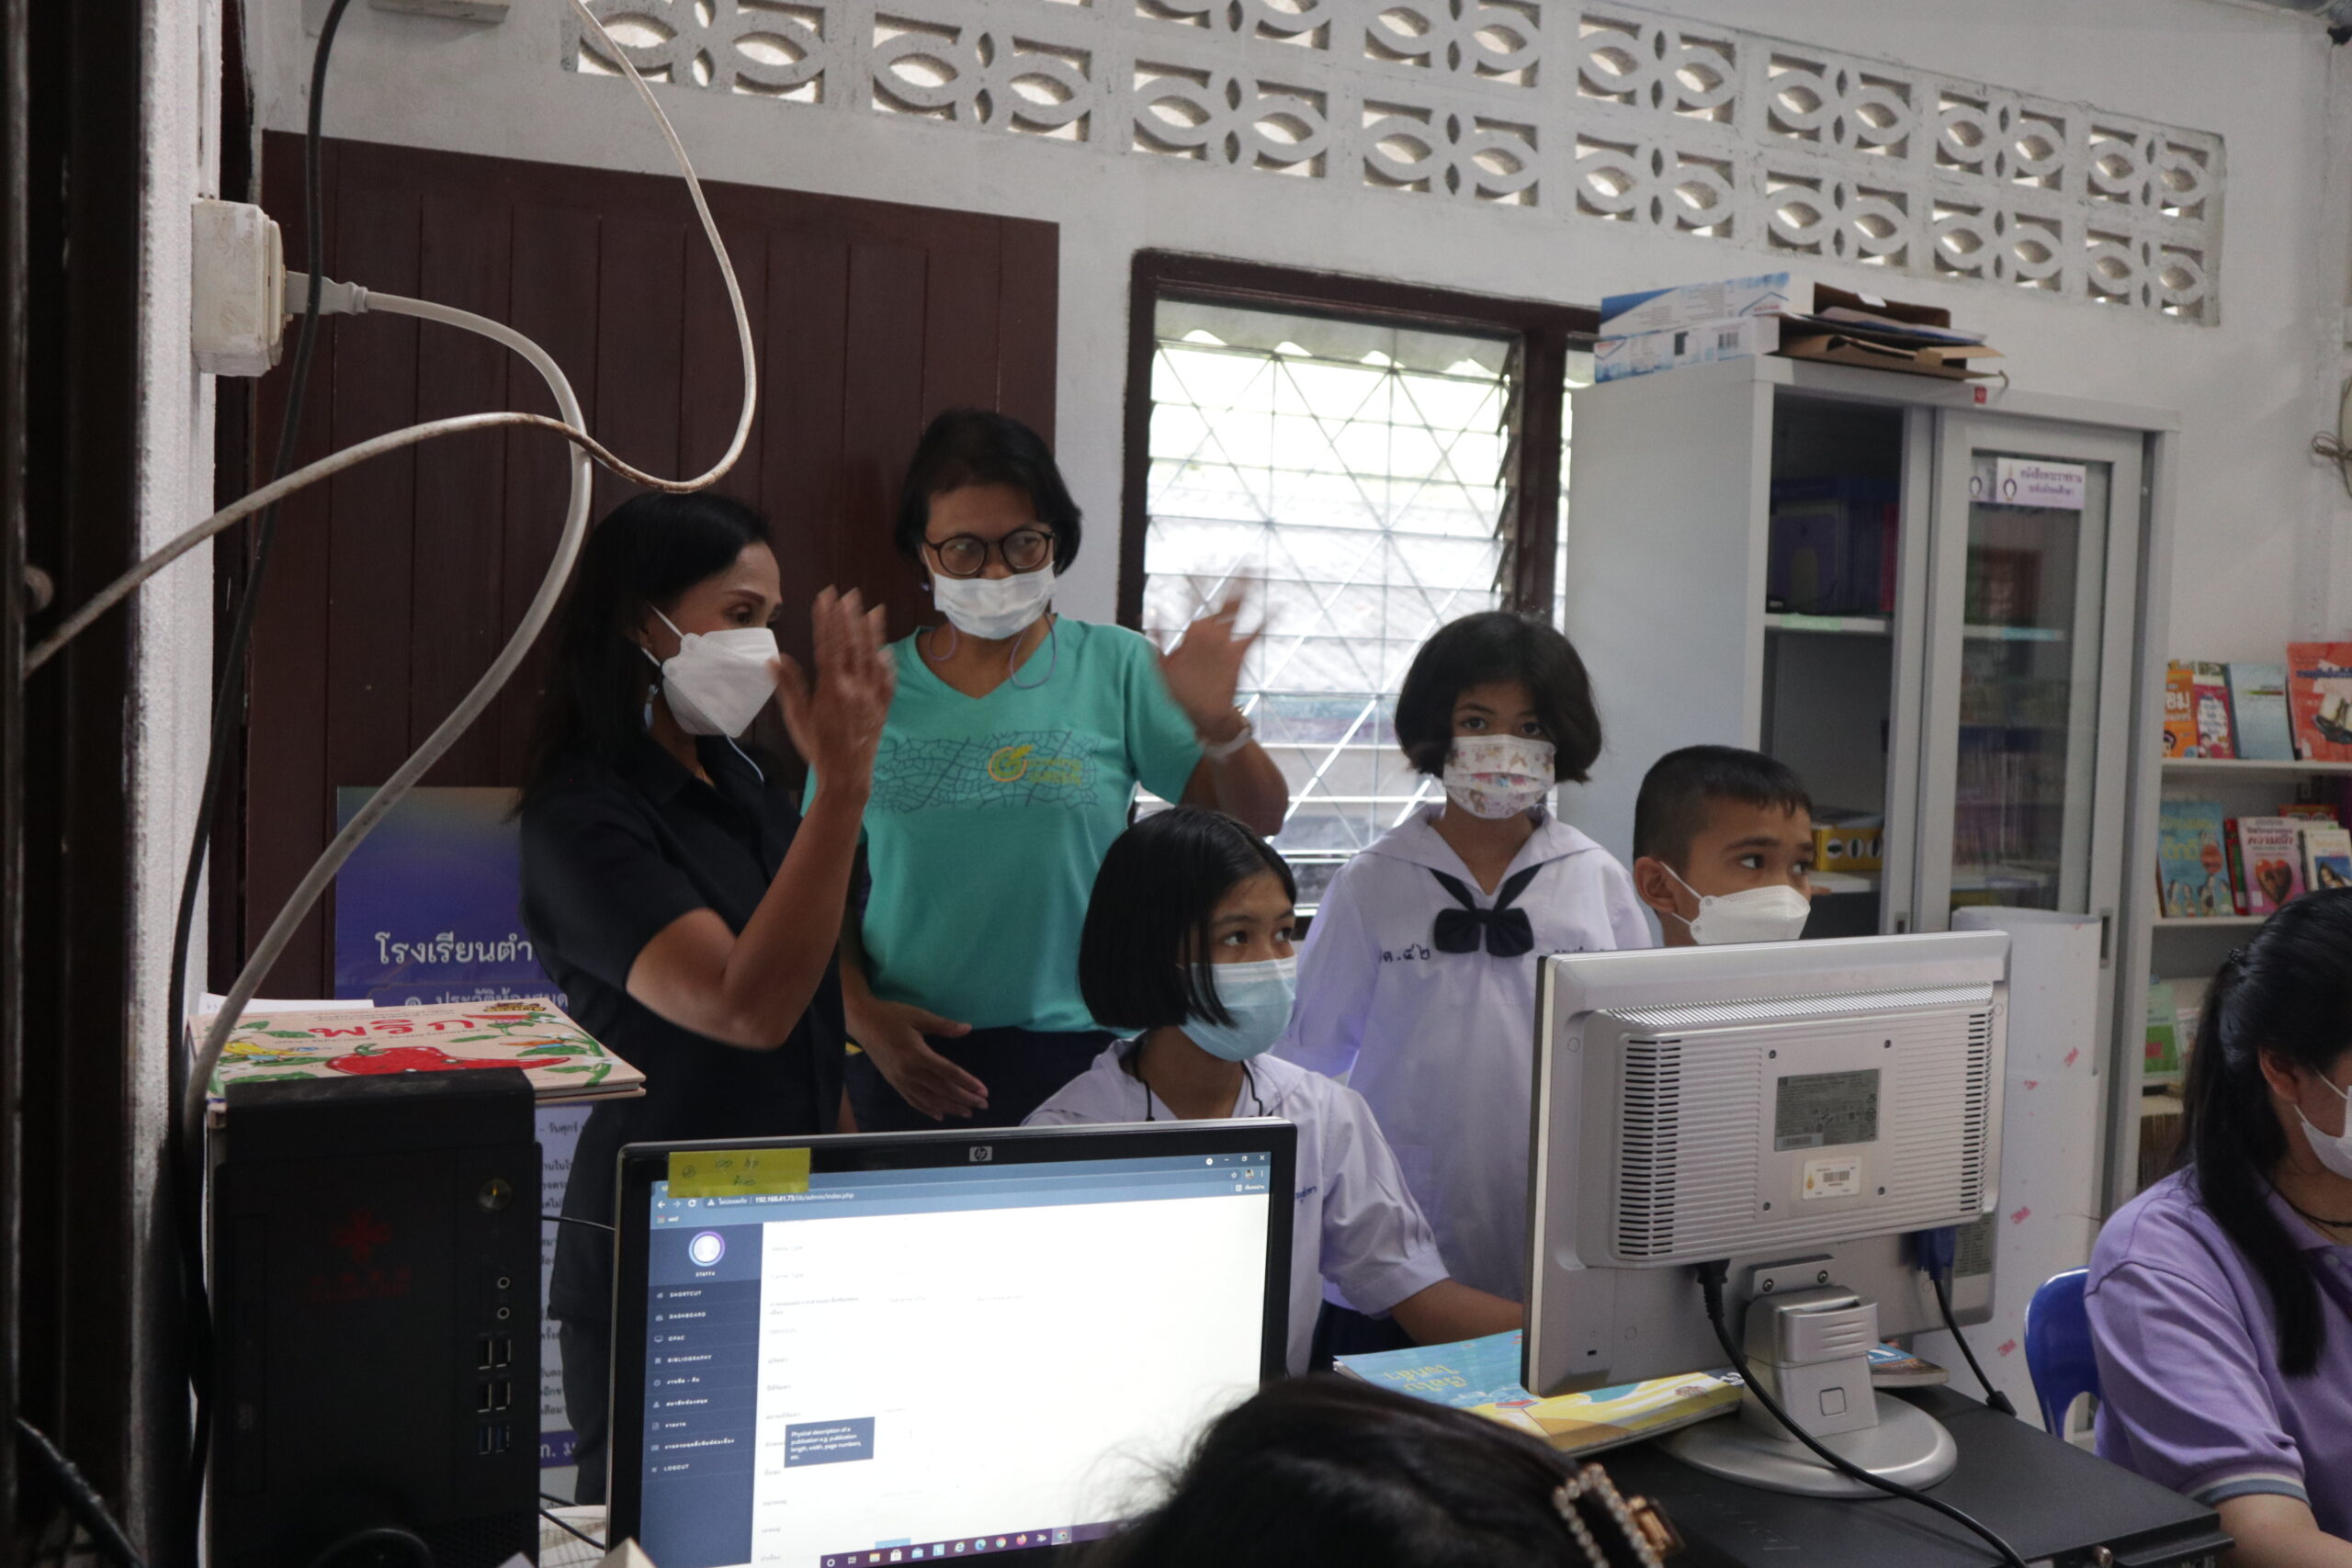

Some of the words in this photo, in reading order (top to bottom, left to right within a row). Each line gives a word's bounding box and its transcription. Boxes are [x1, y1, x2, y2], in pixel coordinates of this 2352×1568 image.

[308, 1019, 475, 1043] พริก
[669, 1290, 702, 1298] SHORTCUT
[669, 1312, 707, 1320] DASHBOARD
[666, 1354, 713, 1364] BIBLIOGRAPHY
[812, 1428, 840, 1437] description
